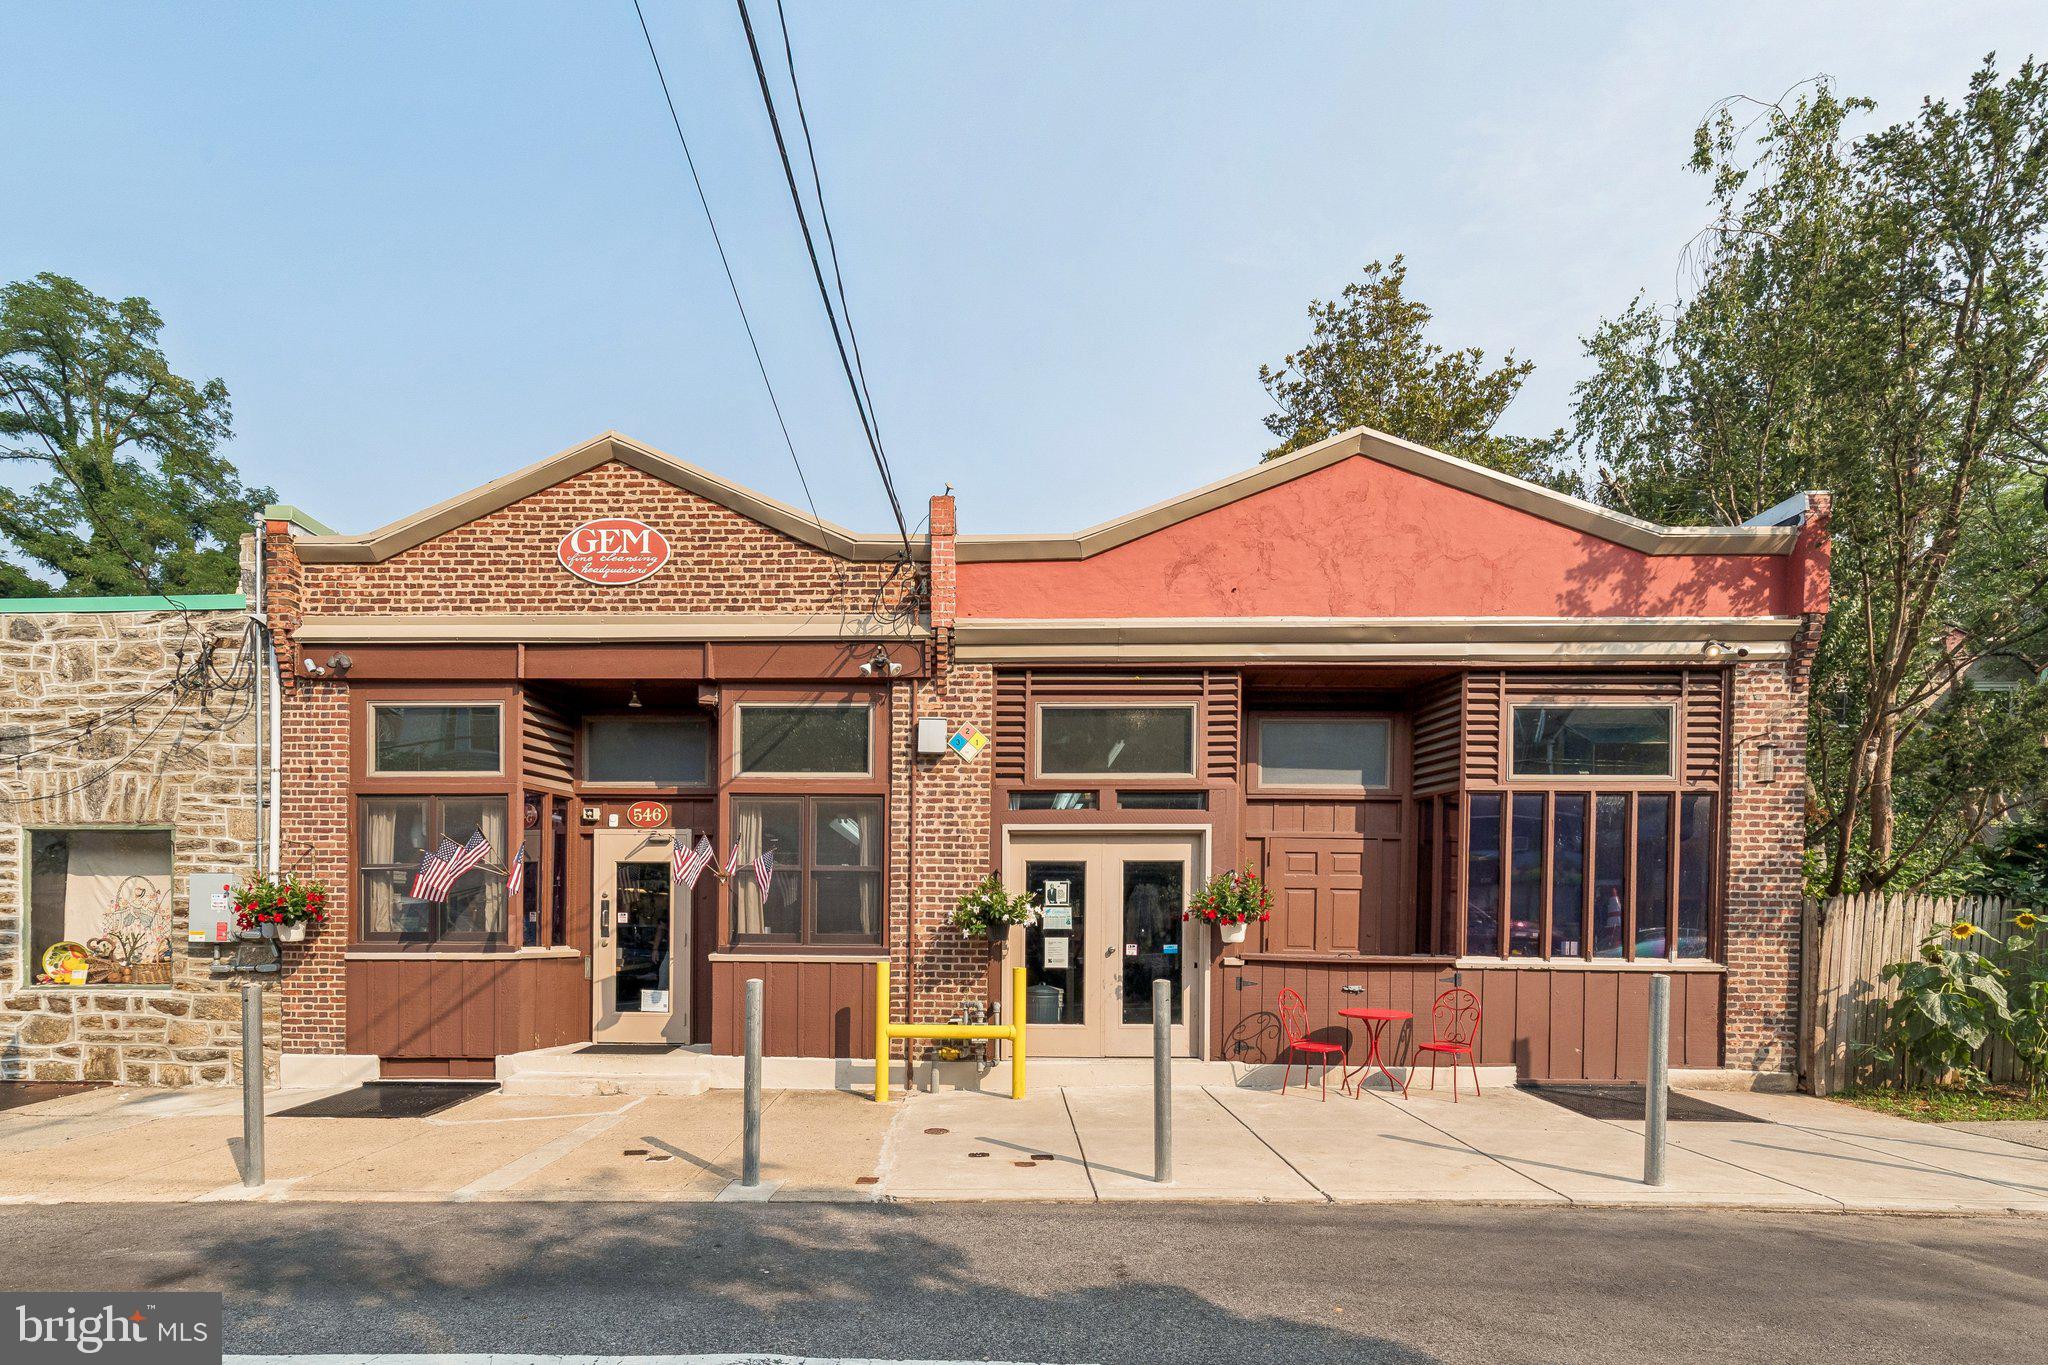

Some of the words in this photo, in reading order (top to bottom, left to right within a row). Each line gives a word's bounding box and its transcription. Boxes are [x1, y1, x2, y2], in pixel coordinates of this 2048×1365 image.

[571, 529, 651, 554] GEM
[567, 554, 593, 567] fine
[581, 563, 647, 578] headquarters
[633, 807, 662, 822] 546
